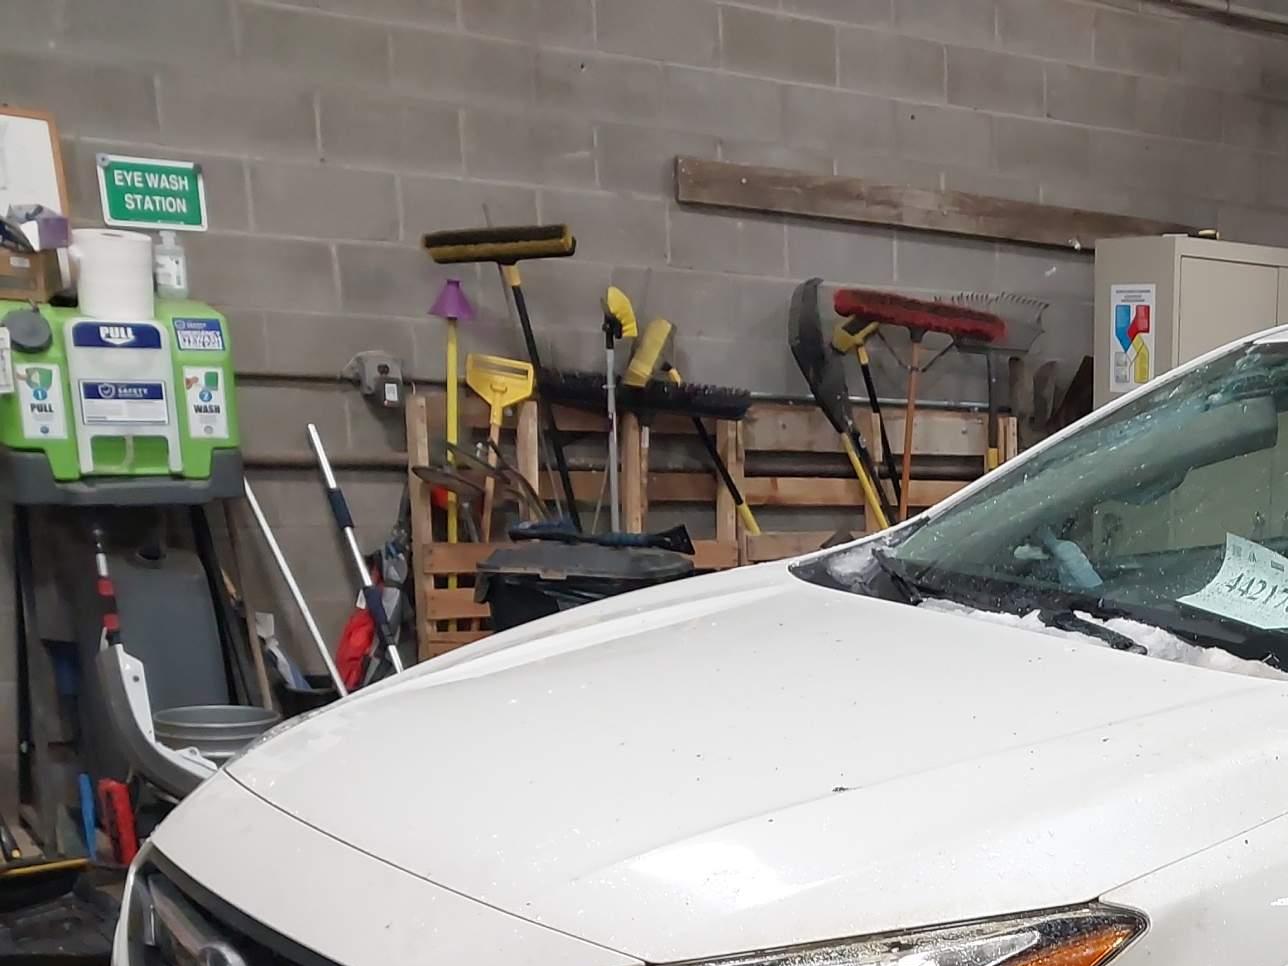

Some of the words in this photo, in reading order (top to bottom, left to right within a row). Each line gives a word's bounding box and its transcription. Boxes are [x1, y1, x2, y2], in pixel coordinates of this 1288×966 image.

[113, 169, 144, 187] EYE
[145, 172, 189, 191] WASH
[124, 193, 187, 213] STATION
[99, 326, 135, 339] PULL
[30, 403, 54, 413] PULL
[193, 404, 221, 414] WASH
